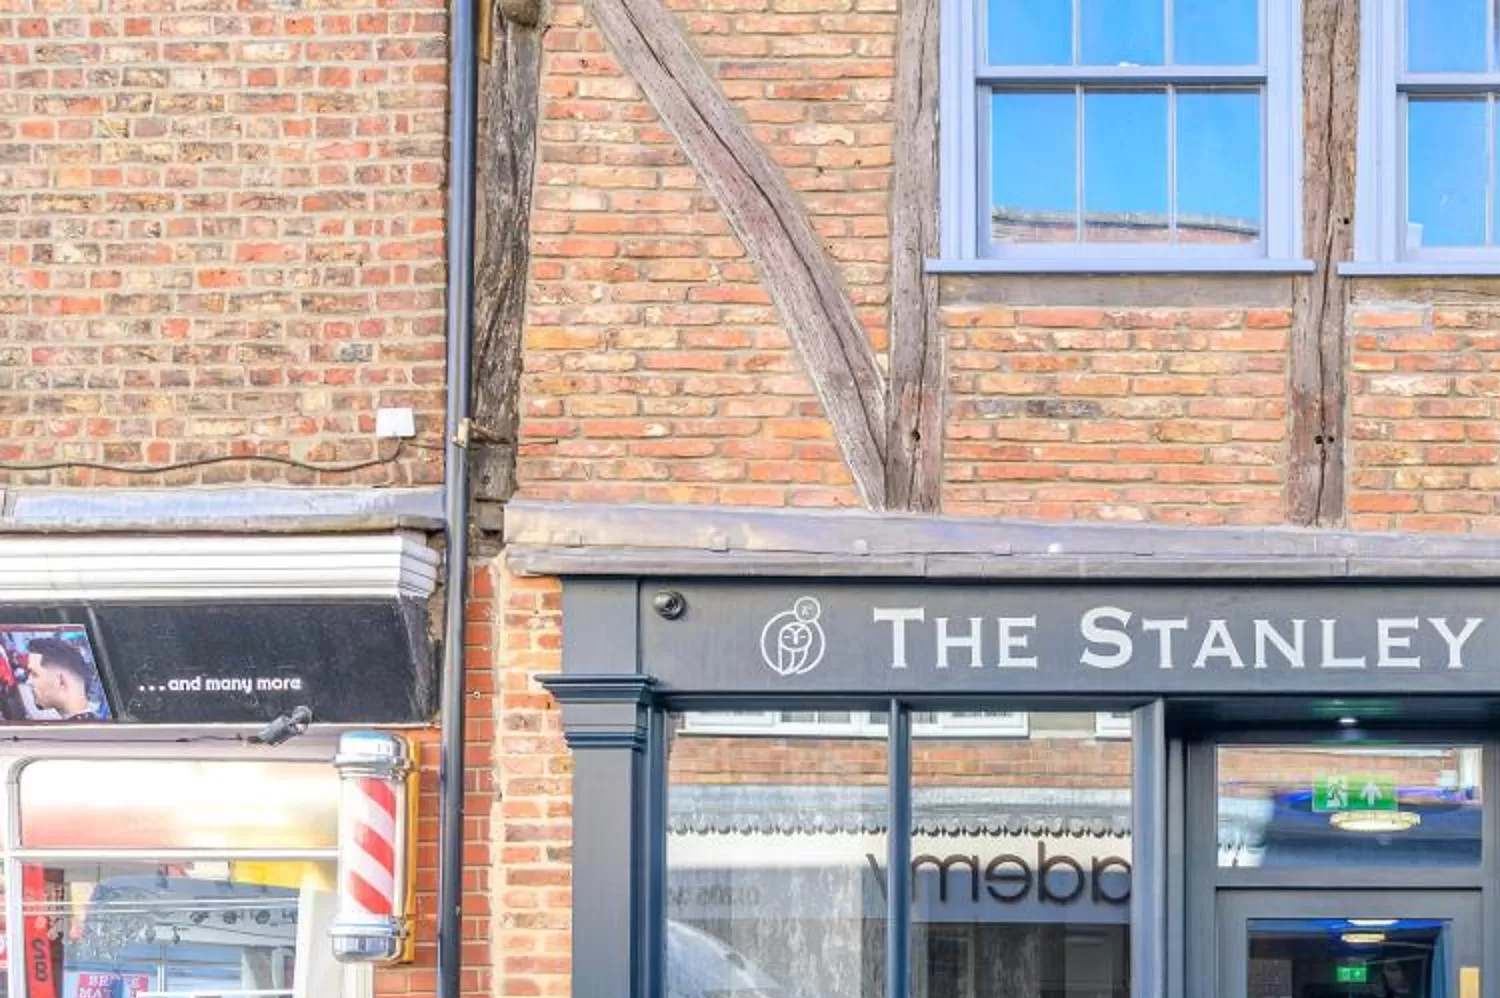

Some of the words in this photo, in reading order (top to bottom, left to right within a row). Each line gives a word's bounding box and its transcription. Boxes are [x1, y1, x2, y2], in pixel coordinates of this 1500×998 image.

[872, 606, 1039, 670] THE
[1079, 605, 1486, 670] STANLEY
[205, 677, 253, 694] many
[256, 677, 302, 691] more
